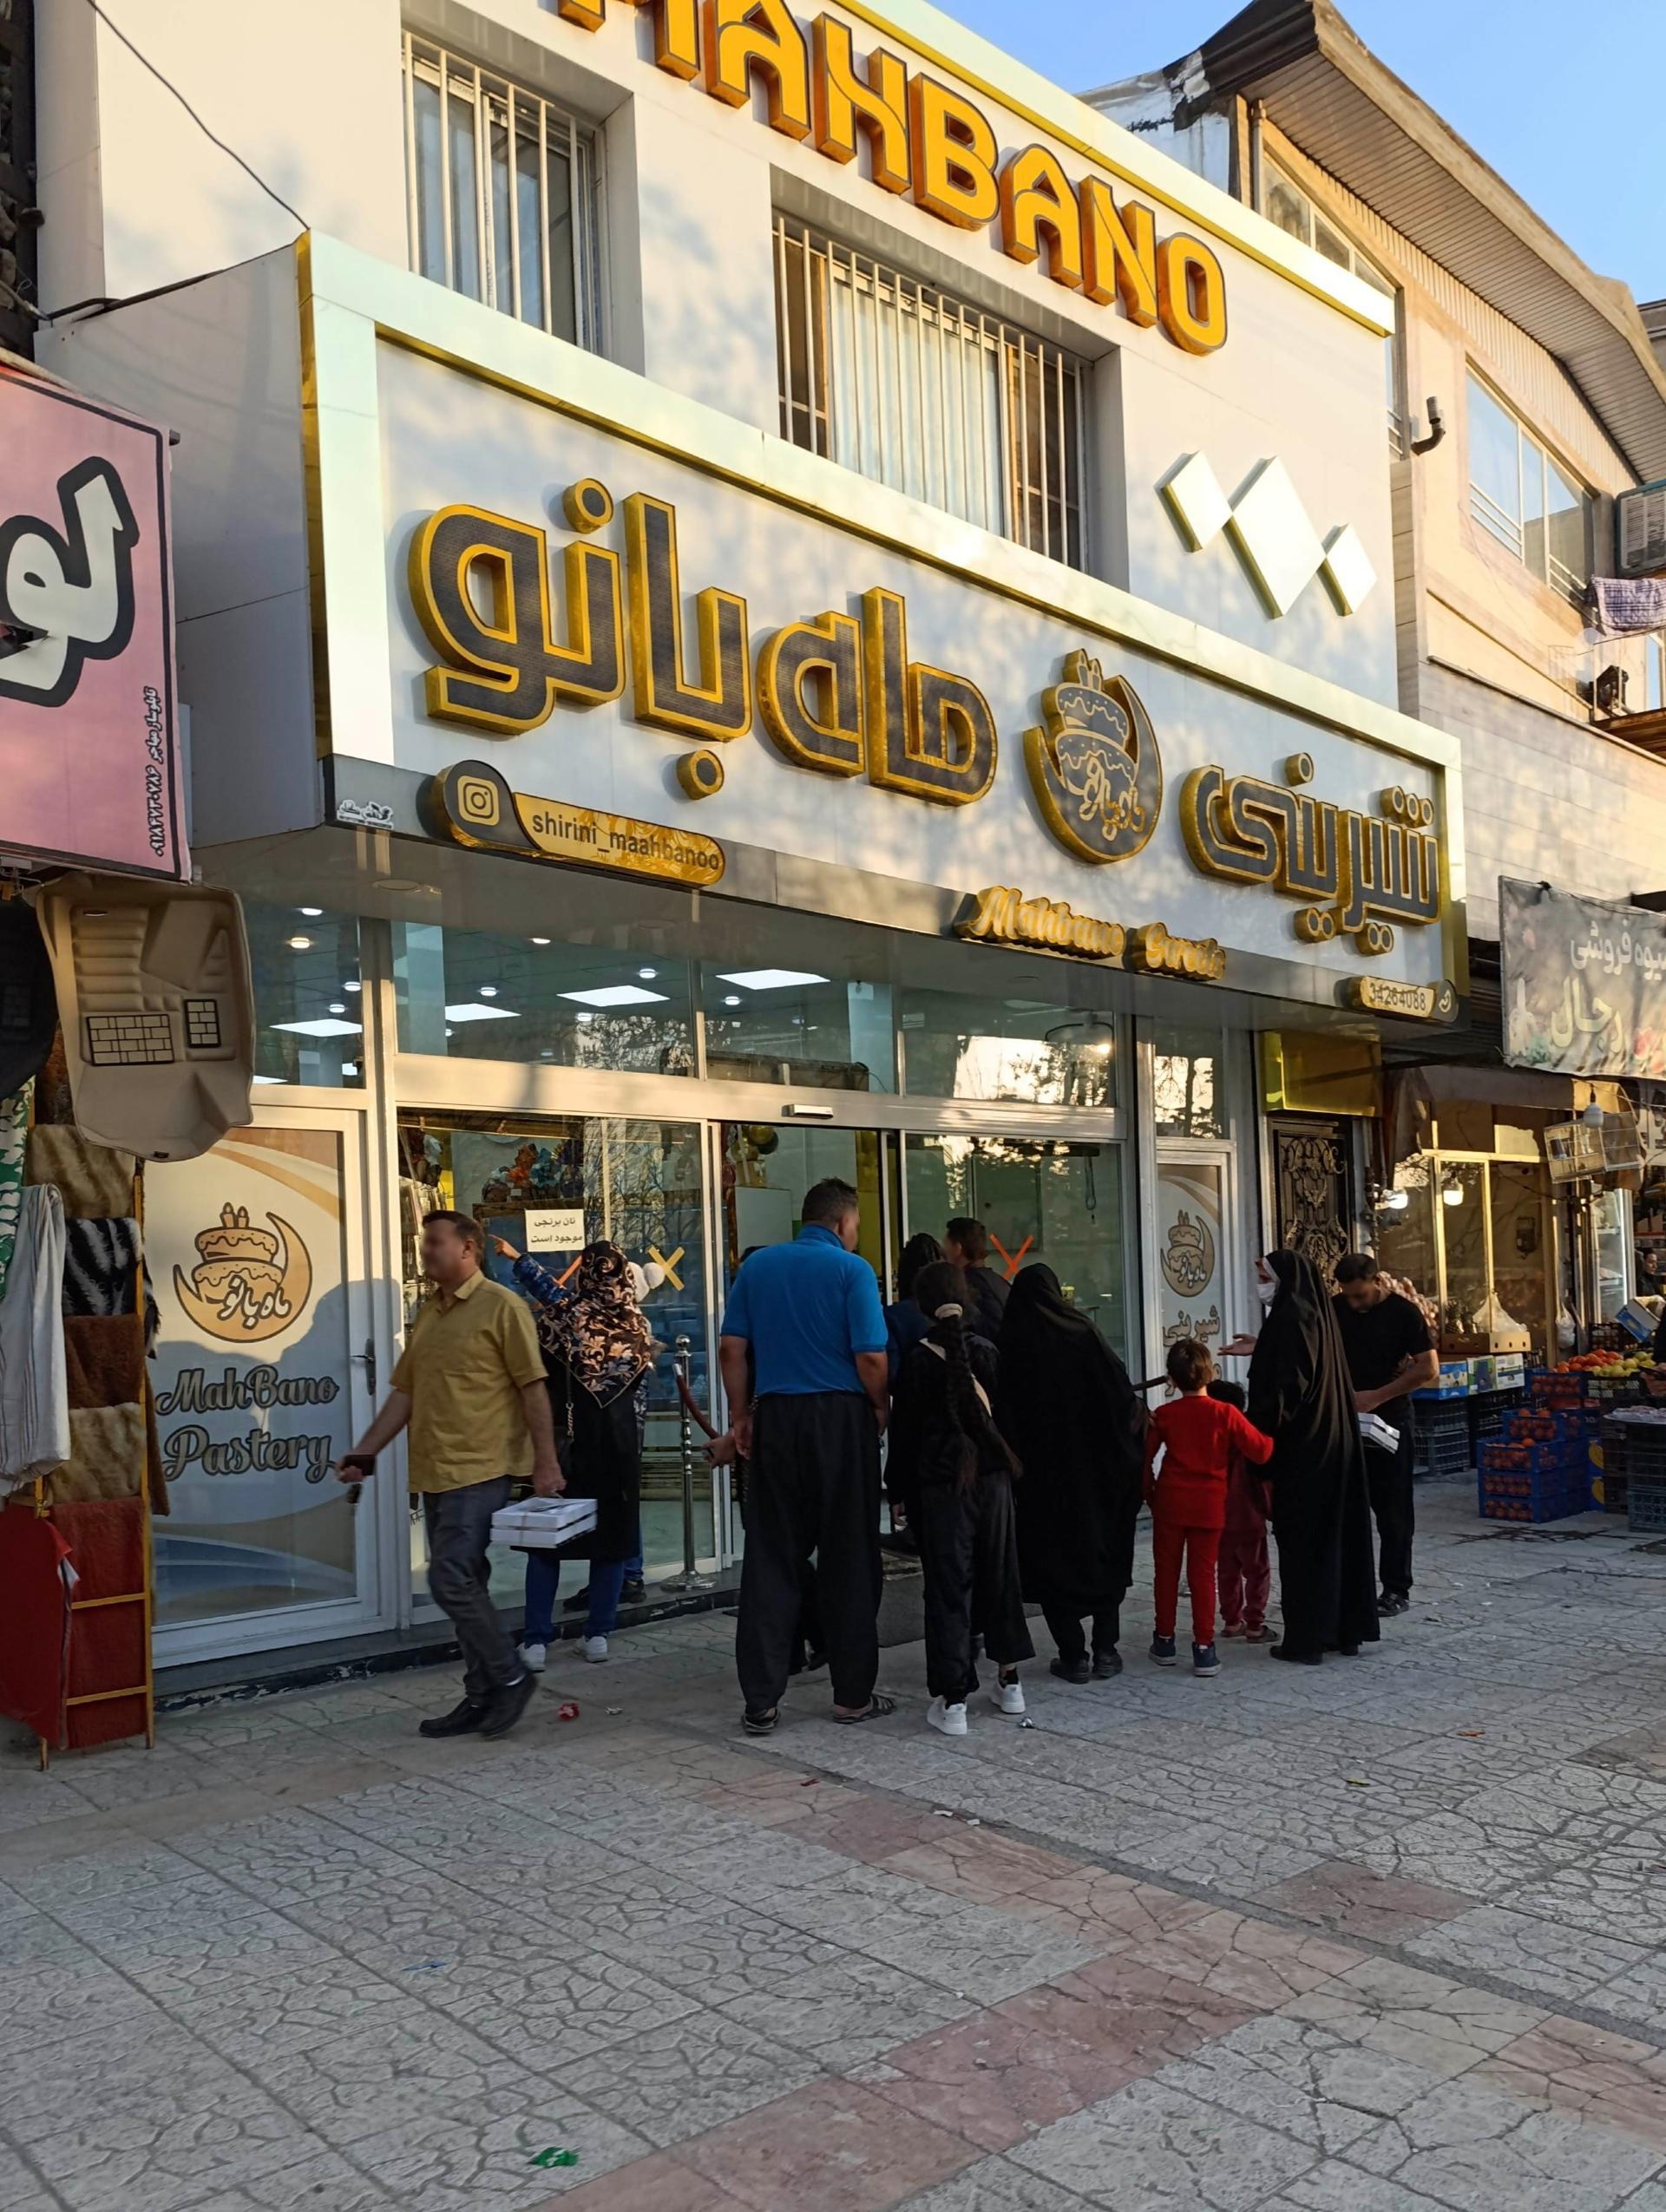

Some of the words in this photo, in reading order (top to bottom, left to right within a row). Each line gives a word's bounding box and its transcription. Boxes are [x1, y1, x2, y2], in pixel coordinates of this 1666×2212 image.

[408, 478, 752, 800] بانو
[758, 586, 998, 805] ماه
[532, 811, 719, 871] shirini_maahbanoo
[1180, 752, 1440, 955] شیرینی
[1571, 919, 1631, 975] فروشی
[1635, 940, 1666, 980] یوه
[534, 1218, 561, 1227] برنجی
[554, 1235, 582, 1244] موجود
[563, 1217, 575, 1227] نان
[161, 1424, 337, 1484] Pastery
